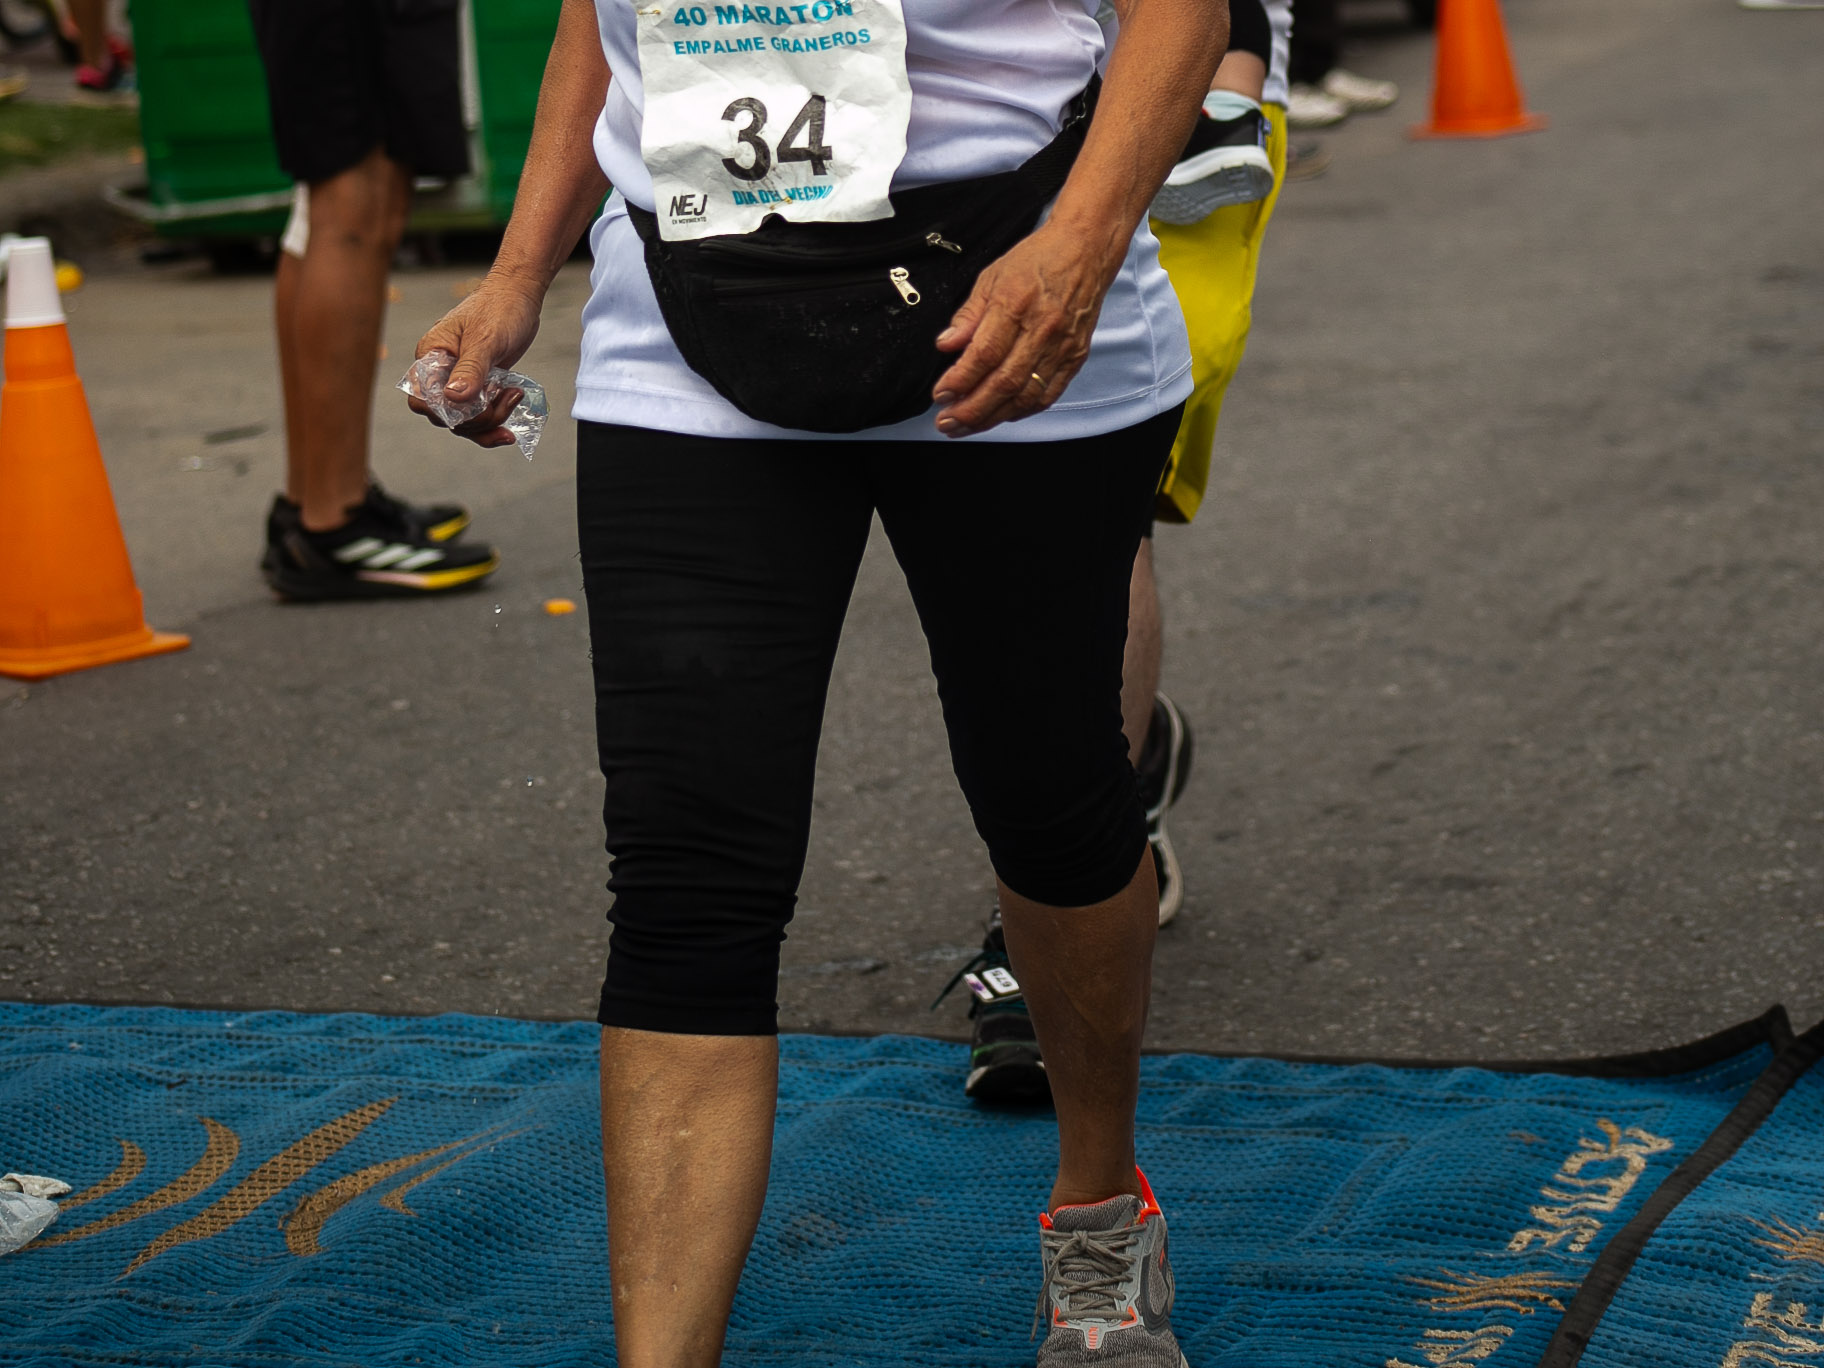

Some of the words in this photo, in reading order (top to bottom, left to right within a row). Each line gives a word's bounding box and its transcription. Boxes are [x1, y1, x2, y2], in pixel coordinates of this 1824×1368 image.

[674, 6, 707, 26] 40
[674, 36, 766, 55] EMPALME
[771, 28, 871, 53] GRANEROS
[721, 94, 833, 181] 34
[669, 194, 708, 216] NEJ
[732, 190, 760, 205] DIA
[758, 189, 782, 204] DEL
